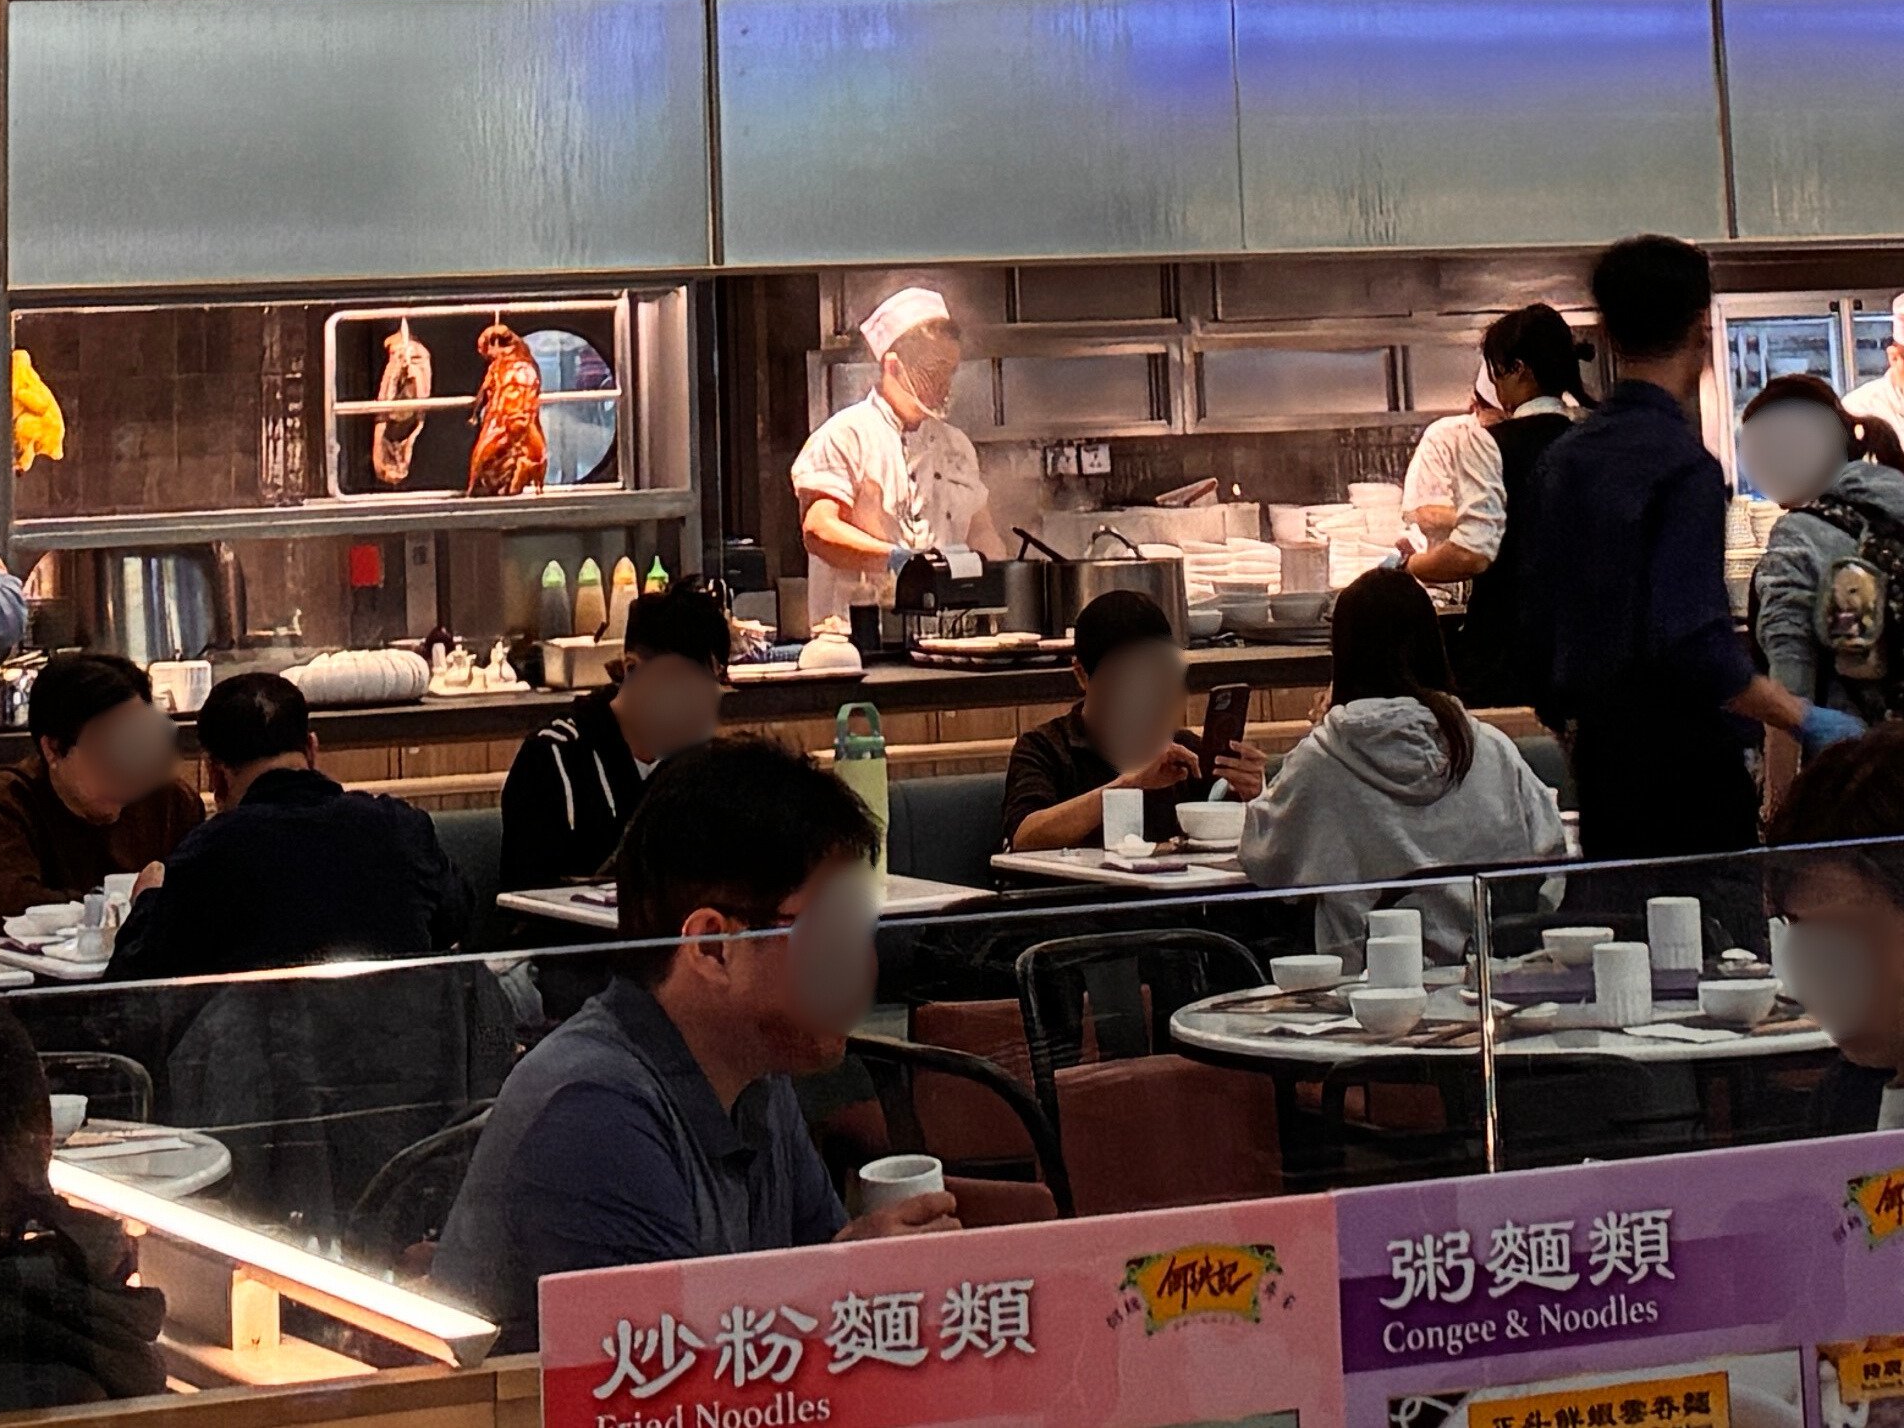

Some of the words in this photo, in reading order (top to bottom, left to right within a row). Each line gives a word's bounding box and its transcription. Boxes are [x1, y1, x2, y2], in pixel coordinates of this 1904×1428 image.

[1379, 1209, 1675, 1309] 粥麵類
[593, 1278, 1036, 1399] 炒粉麵類
[1382, 1315, 1496, 1355] Congee
[1505, 1308, 1530, 1339] &
[1539, 1294, 1659, 1335] Noodles
[696, 1391, 830, 1428] Noodles
